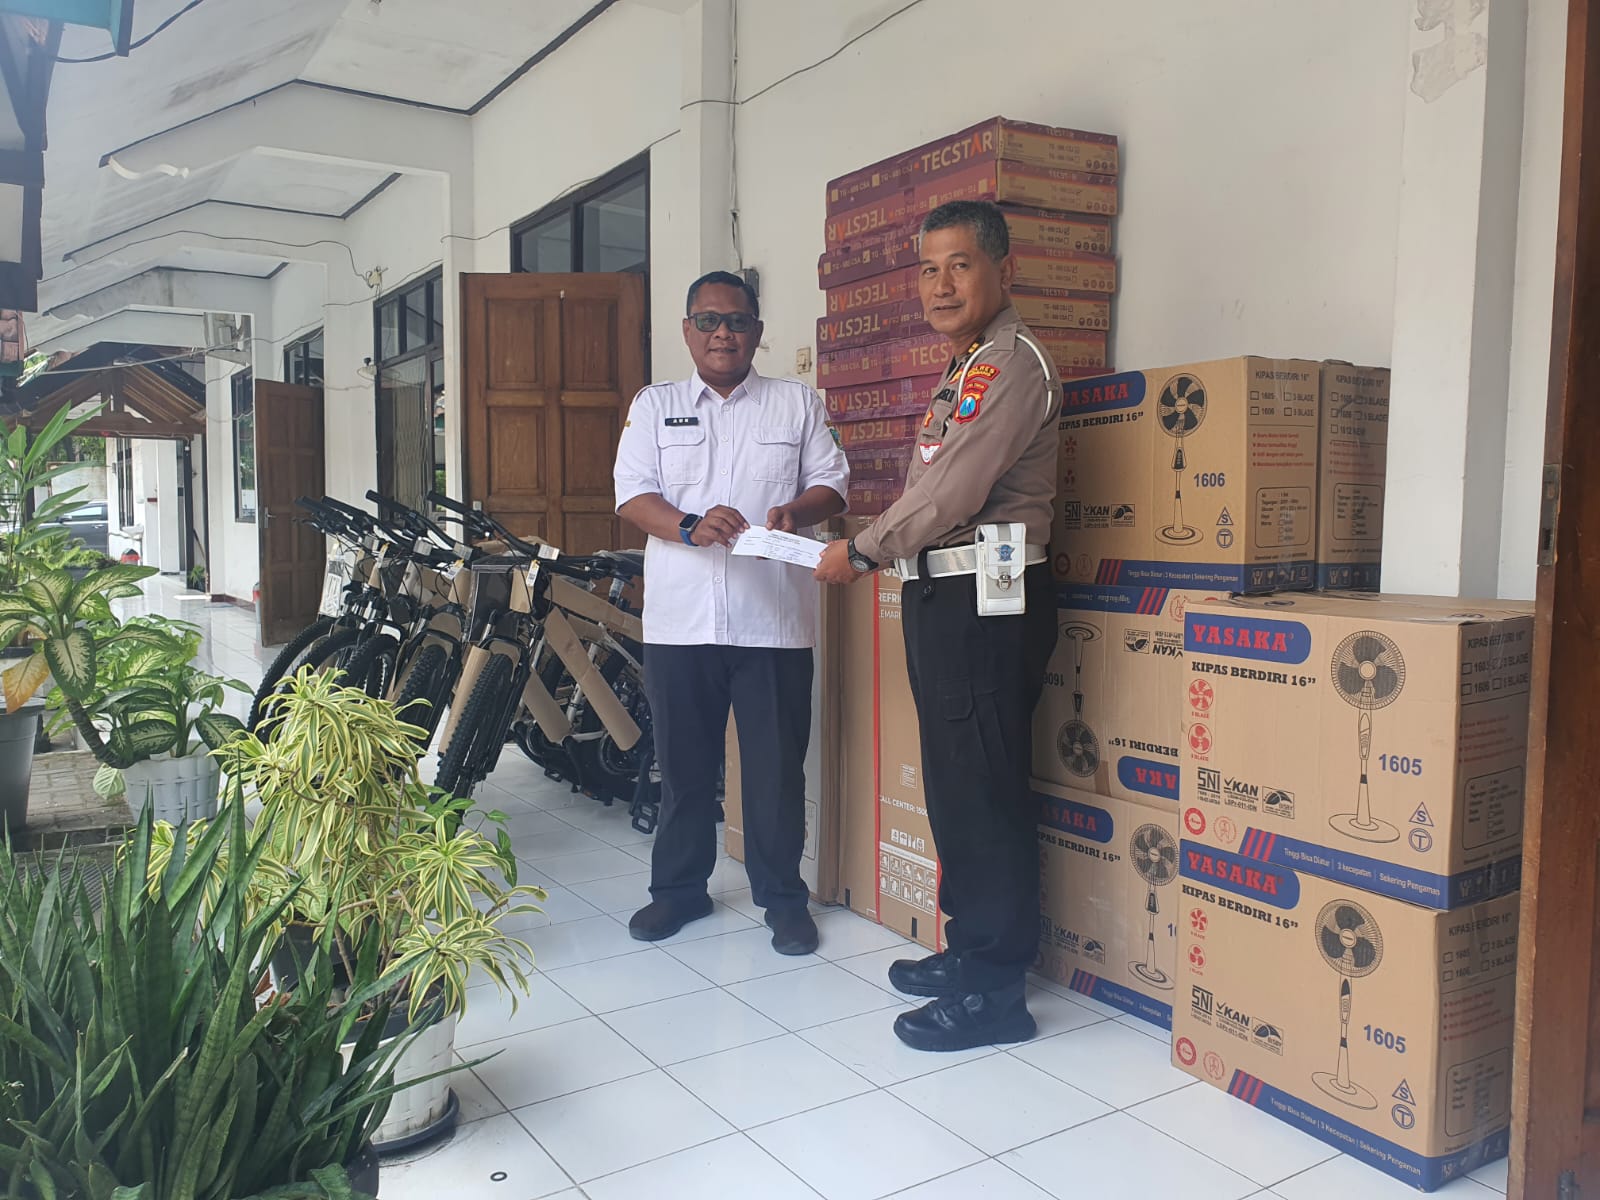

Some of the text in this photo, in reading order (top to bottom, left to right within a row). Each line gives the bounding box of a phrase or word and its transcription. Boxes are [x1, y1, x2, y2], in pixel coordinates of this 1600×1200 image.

[921, 130, 993, 174] TECSTAR
[828, 207, 887, 242] TECSTAR
[830, 281, 888, 312] TECSTAR
[820, 313, 881, 342] TECSTAR
[910, 342, 953, 367] TECS
[1256, 369, 1274, 380] KIPAS
[829, 389, 890, 414] TECSTAR
[1082, 413, 1124, 427] BERDIRI
[1194, 472, 1225, 488] 1606
[1065, 503, 1081, 518] SNI
[879, 609, 901, 620] EMARI
[1193, 624, 1287, 652] YASAKA
[1192, 661, 1228, 676] KIPAS
[1230, 666, 1288, 684] BERDIRI
[1129, 740, 1179, 757] BERDIRI
[1379, 753, 1422, 776] 1605
[1198, 770, 1220, 791] SNI
[1233, 781, 1259, 797] KAN
[1417, 810, 1426, 823] S
[1058, 838, 1100, 858] BERDIRI
[1188, 850, 1277, 895] YASAKA
[1379, 873, 1406, 888] Sekering
[1407, 880, 1441, 896] Pengaman
[1182, 884, 1216, 904] KIPAS
[1218, 896, 1272, 923] BERDIRI
[1060, 929, 1079, 942] KAN
[1192, 988, 1213, 1012] SNI
[1224, 1006, 1250, 1026] KAN
[1364, 1024, 1406, 1054] 1605
[1387, 1153, 1421, 1176] Pengaman
